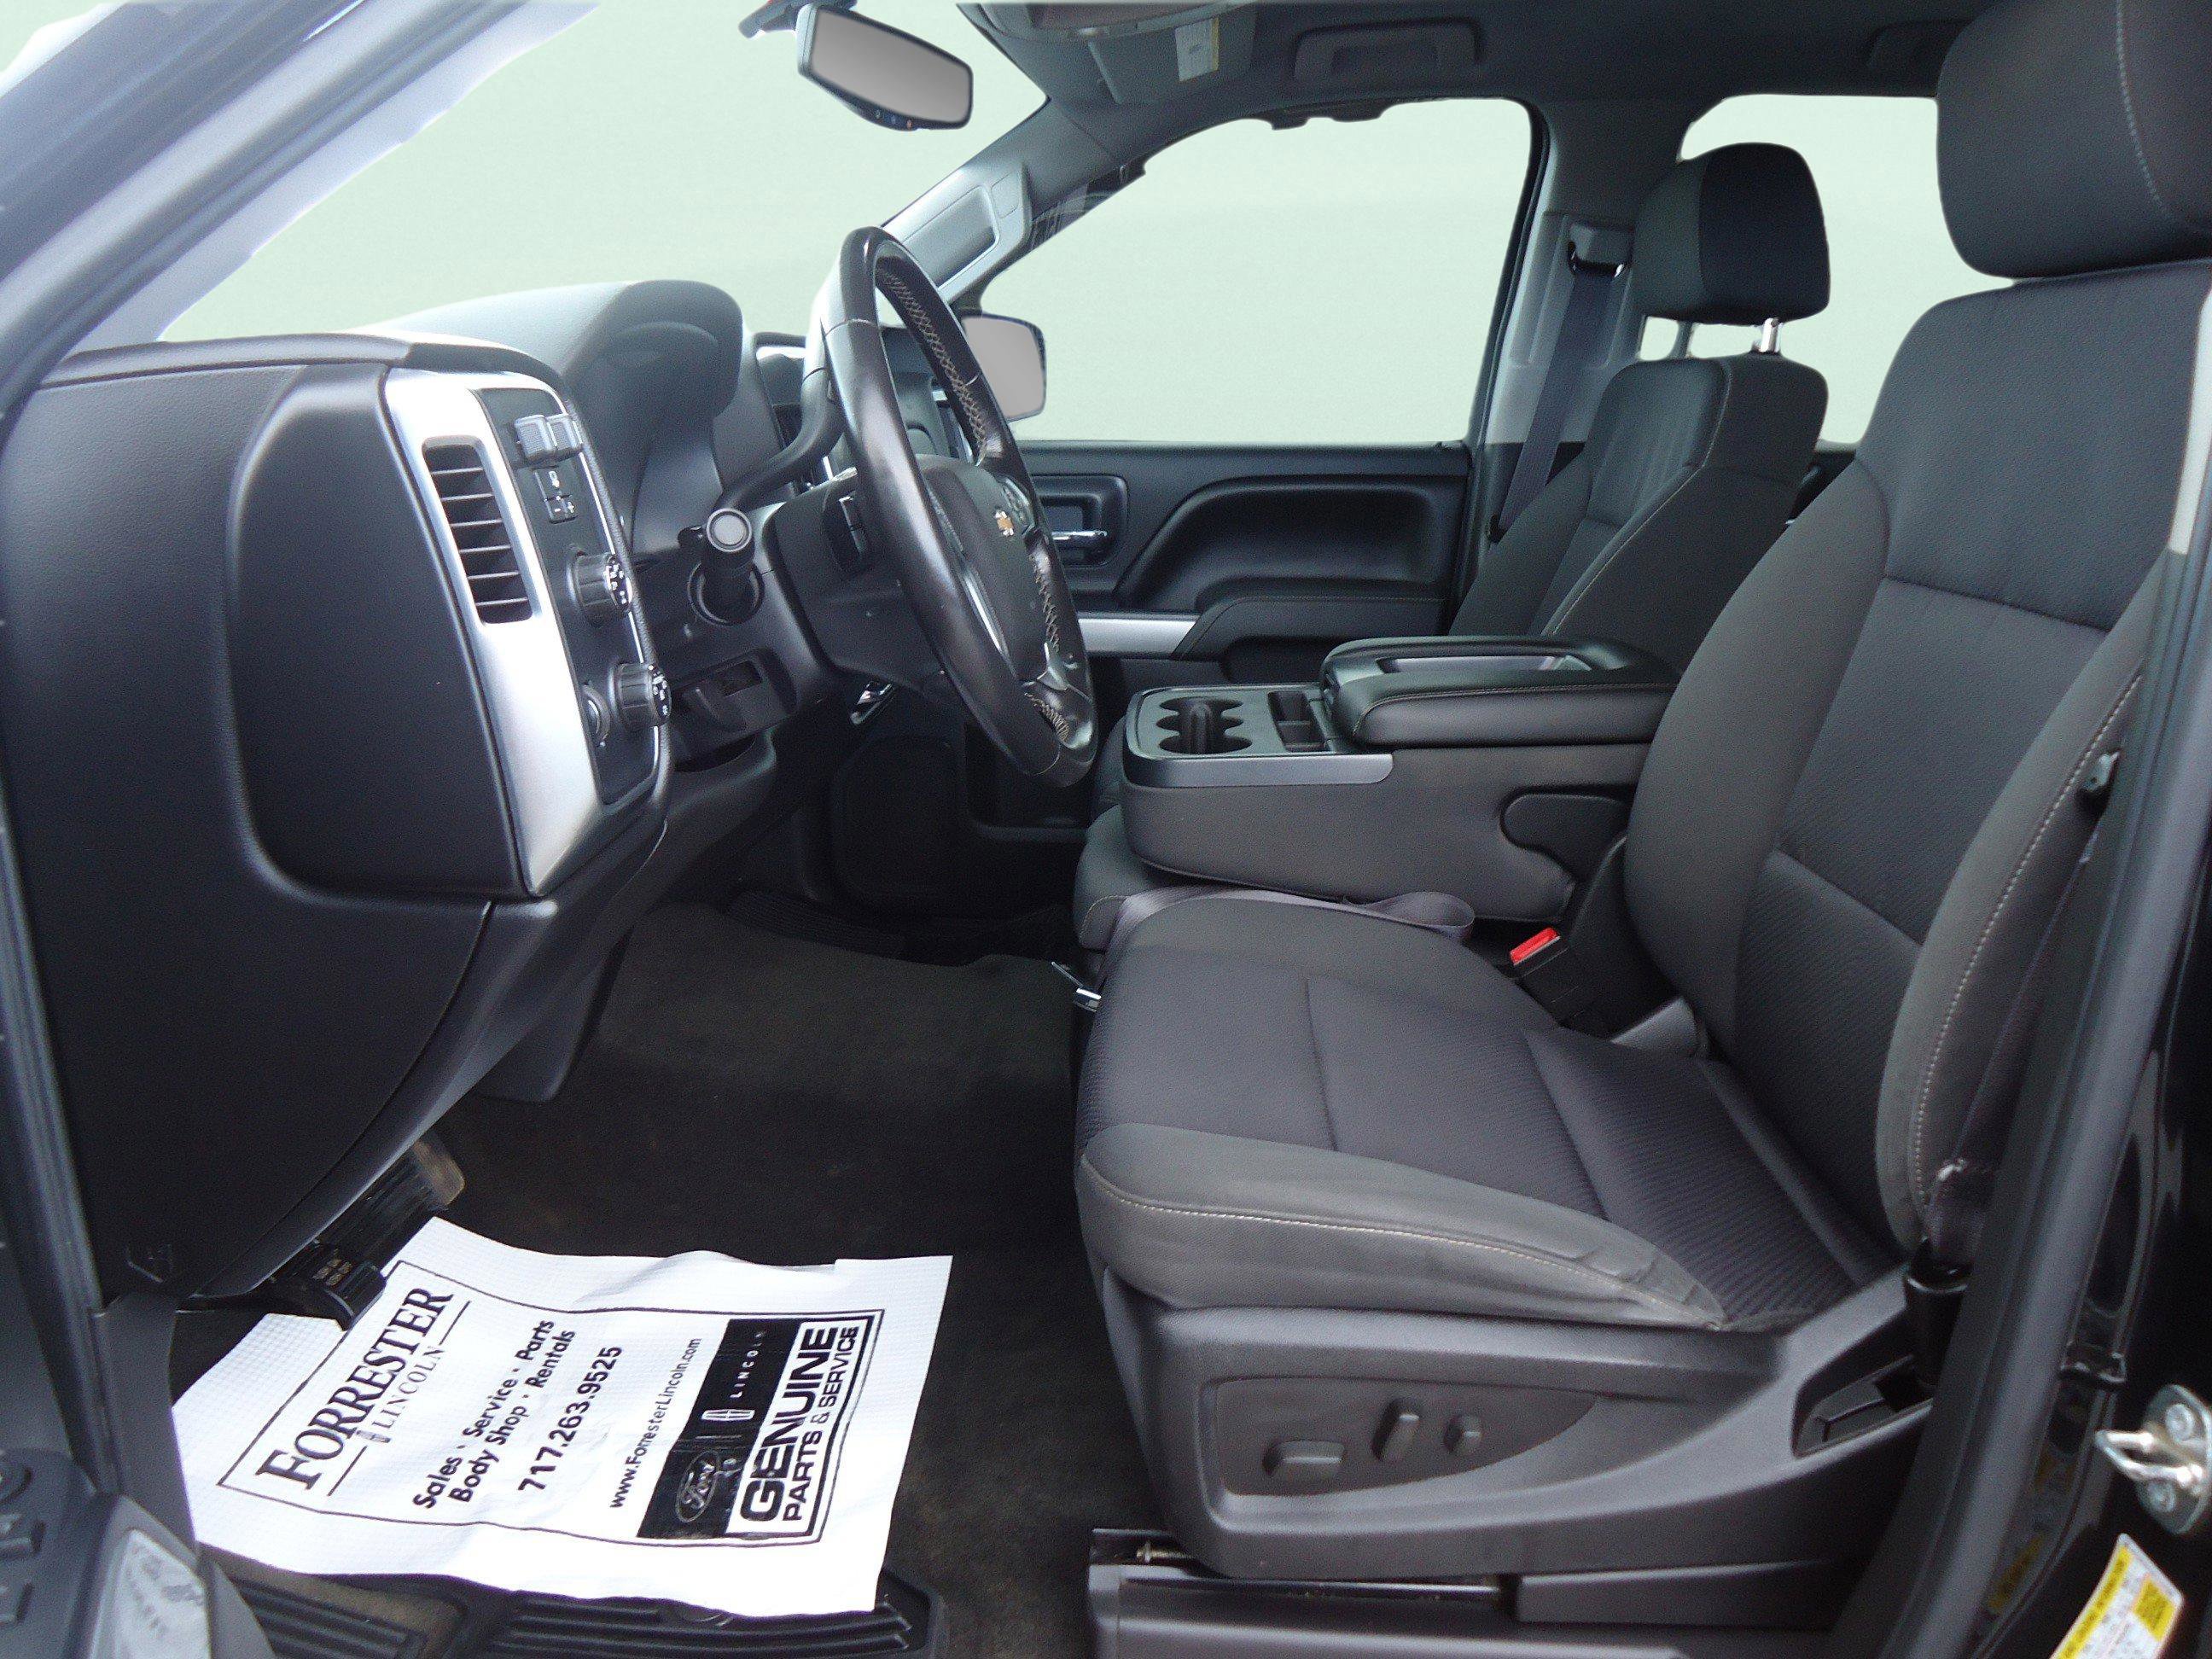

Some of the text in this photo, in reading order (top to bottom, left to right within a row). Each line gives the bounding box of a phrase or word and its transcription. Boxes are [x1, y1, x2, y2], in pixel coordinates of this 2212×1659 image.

[255, 1287, 454, 1490] FORRESTER
[371, 1345, 445, 1430] LINCOLN
[412, 1320, 556, 1509] Sales Service Parts
[447, 1330, 576, 1503] Body Shop Rentals
[517, 1346, 622, 1491] 717.263.9525
[609, 1337, 702, 1508] www.ForresterLincoln.com
[740, 1326, 839, 1522] GENUINE
[782, 1326, 860, 1522] PARTS & SERVICE
